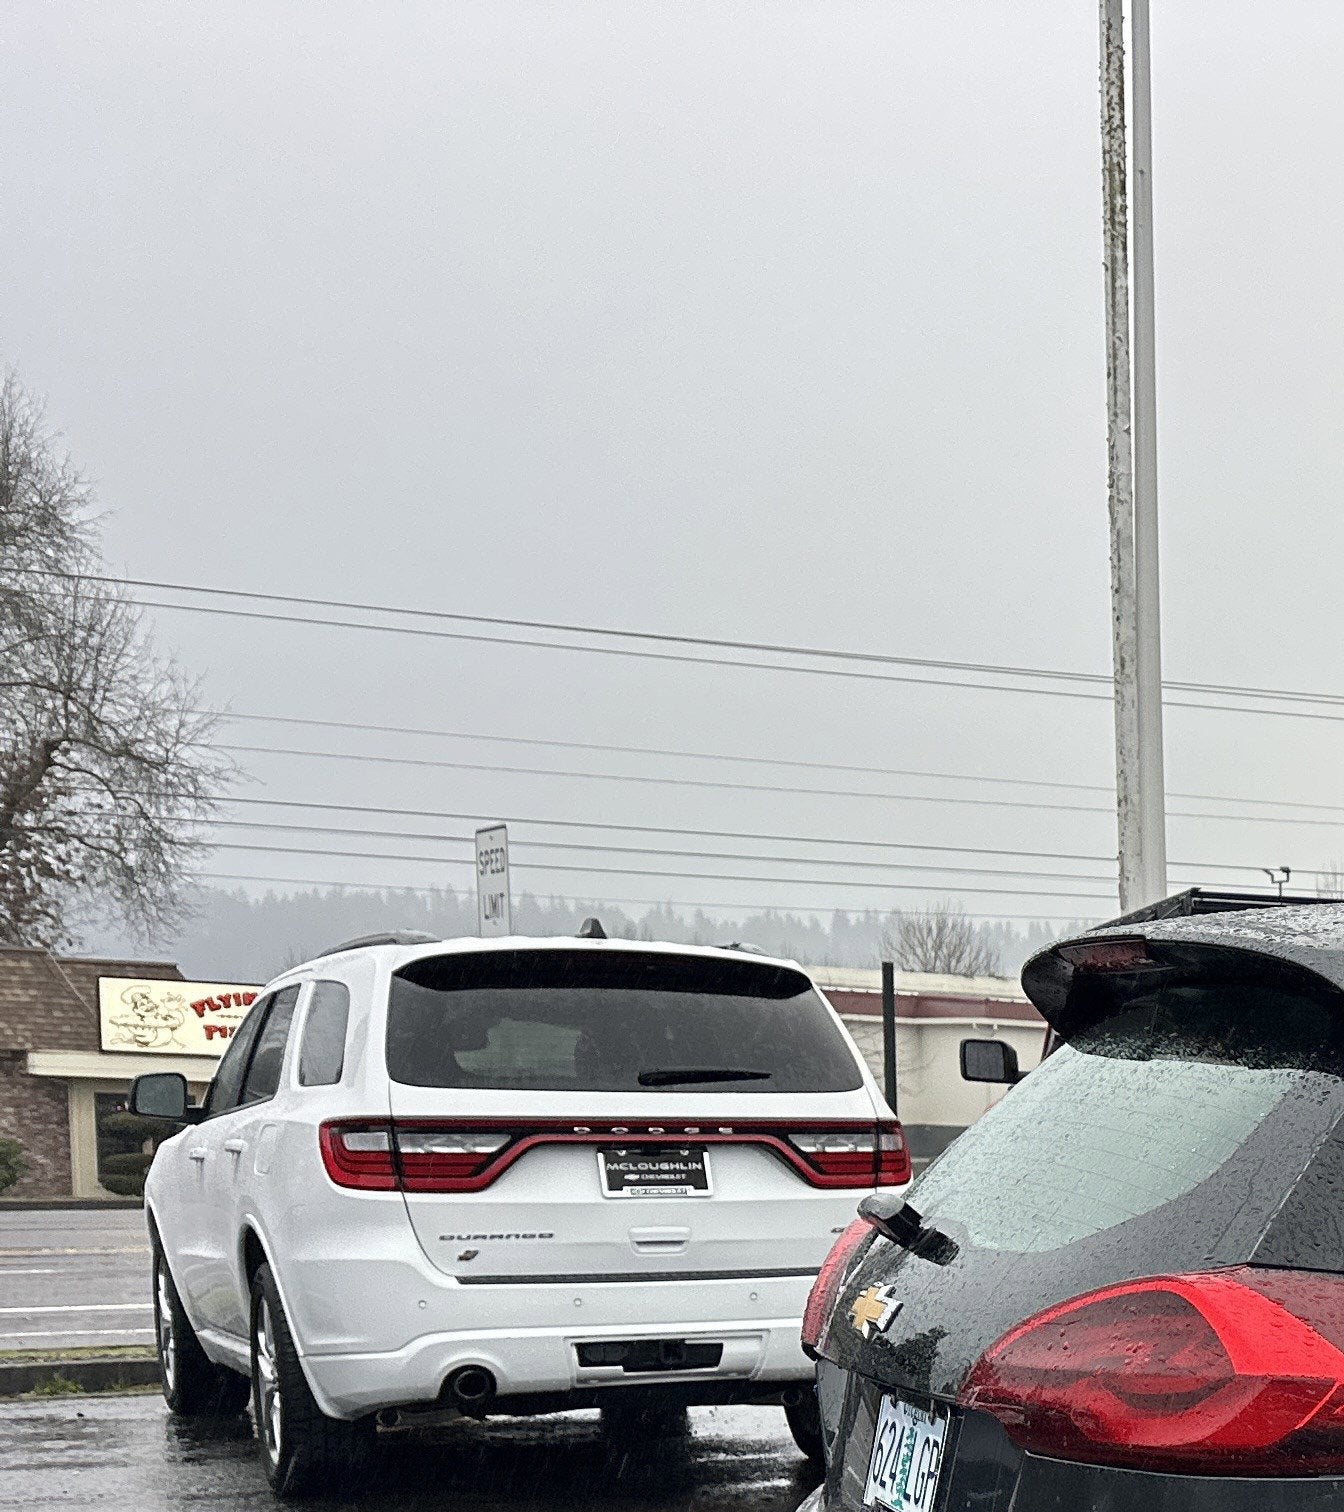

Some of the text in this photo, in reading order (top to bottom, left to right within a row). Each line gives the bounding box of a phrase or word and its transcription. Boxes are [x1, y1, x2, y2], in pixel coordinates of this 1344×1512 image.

[479, 847, 505, 875] SPEED
[483, 892, 505, 920] LIMIT
[190, 992, 258, 1018] FLYIN
[606, 1162, 702, 1171] MCLOUGHLIN
[439, 1233, 554, 1241] DURANGO
